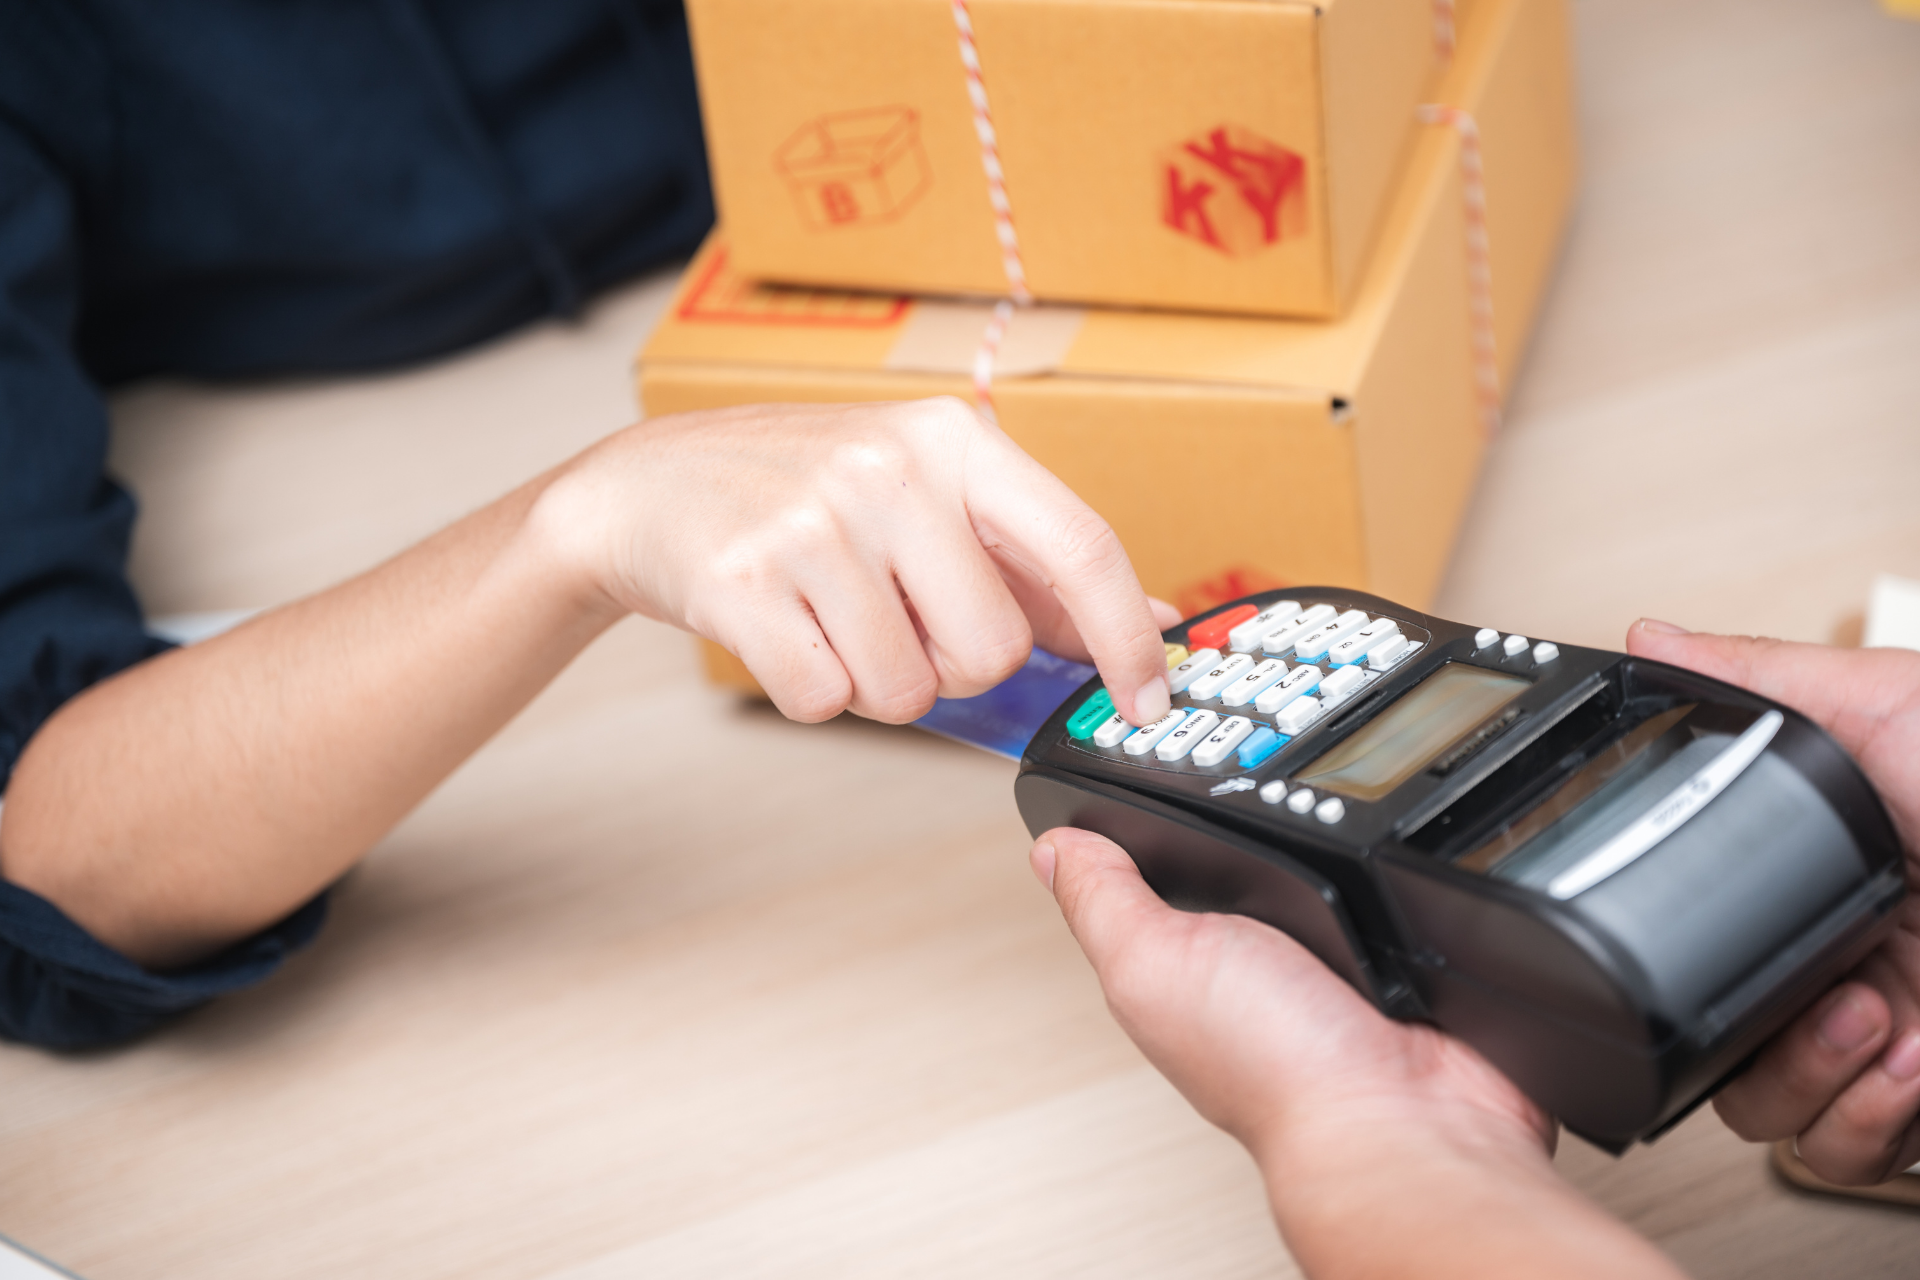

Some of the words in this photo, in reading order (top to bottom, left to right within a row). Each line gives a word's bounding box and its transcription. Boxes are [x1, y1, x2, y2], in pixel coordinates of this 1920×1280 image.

[1325, 623, 1339, 632] 4
[1210, 669, 1225, 677] 8
[1246, 674, 1261, 682] 5
[1275, 680, 1292, 689] 2
[1077, 705, 1104, 723] Enter
[1184, 714, 1206, 729] MNO
[1140, 727, 1155, 735] 9
[1223, 720, 1240, 734] DEF
[1174, 730, 1189, 738] 6
[1210, 734, 1226, 743] 3
